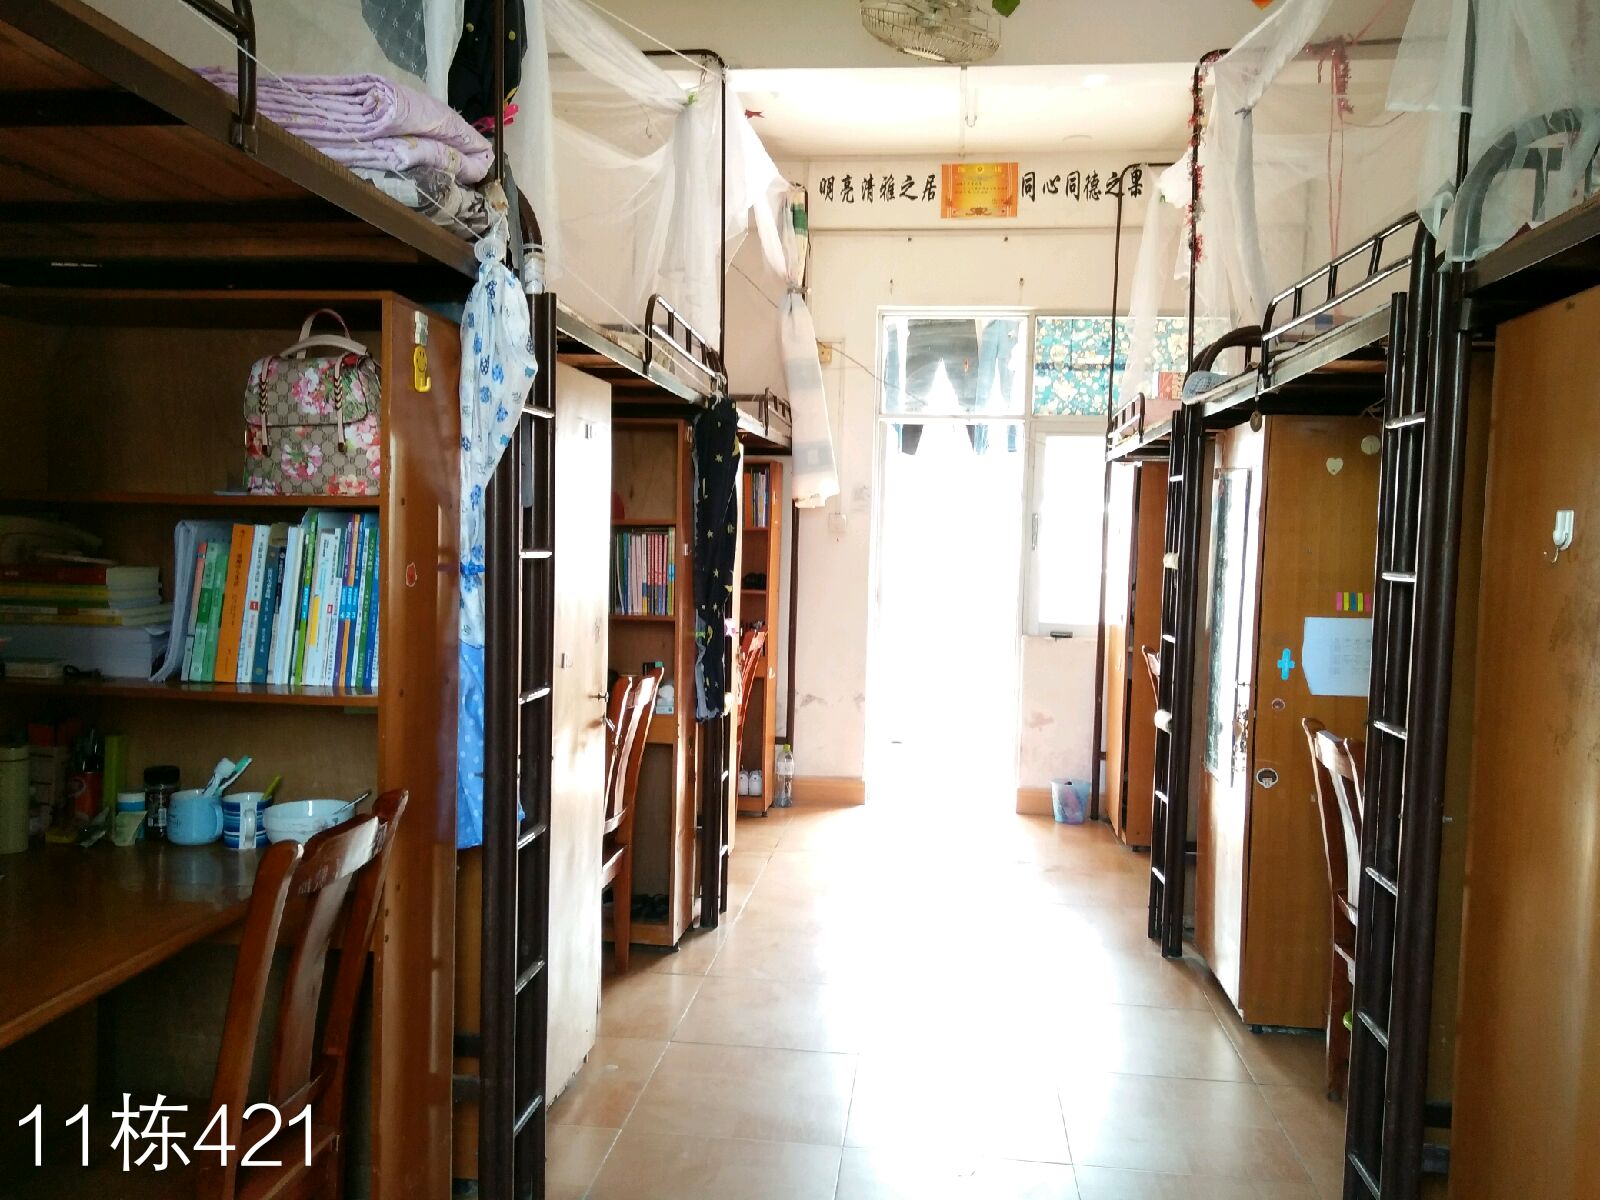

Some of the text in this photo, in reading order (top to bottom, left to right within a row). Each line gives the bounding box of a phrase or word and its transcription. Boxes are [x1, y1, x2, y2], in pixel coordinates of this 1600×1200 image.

[819, 173, 937, 204] 明亮清雅之居
